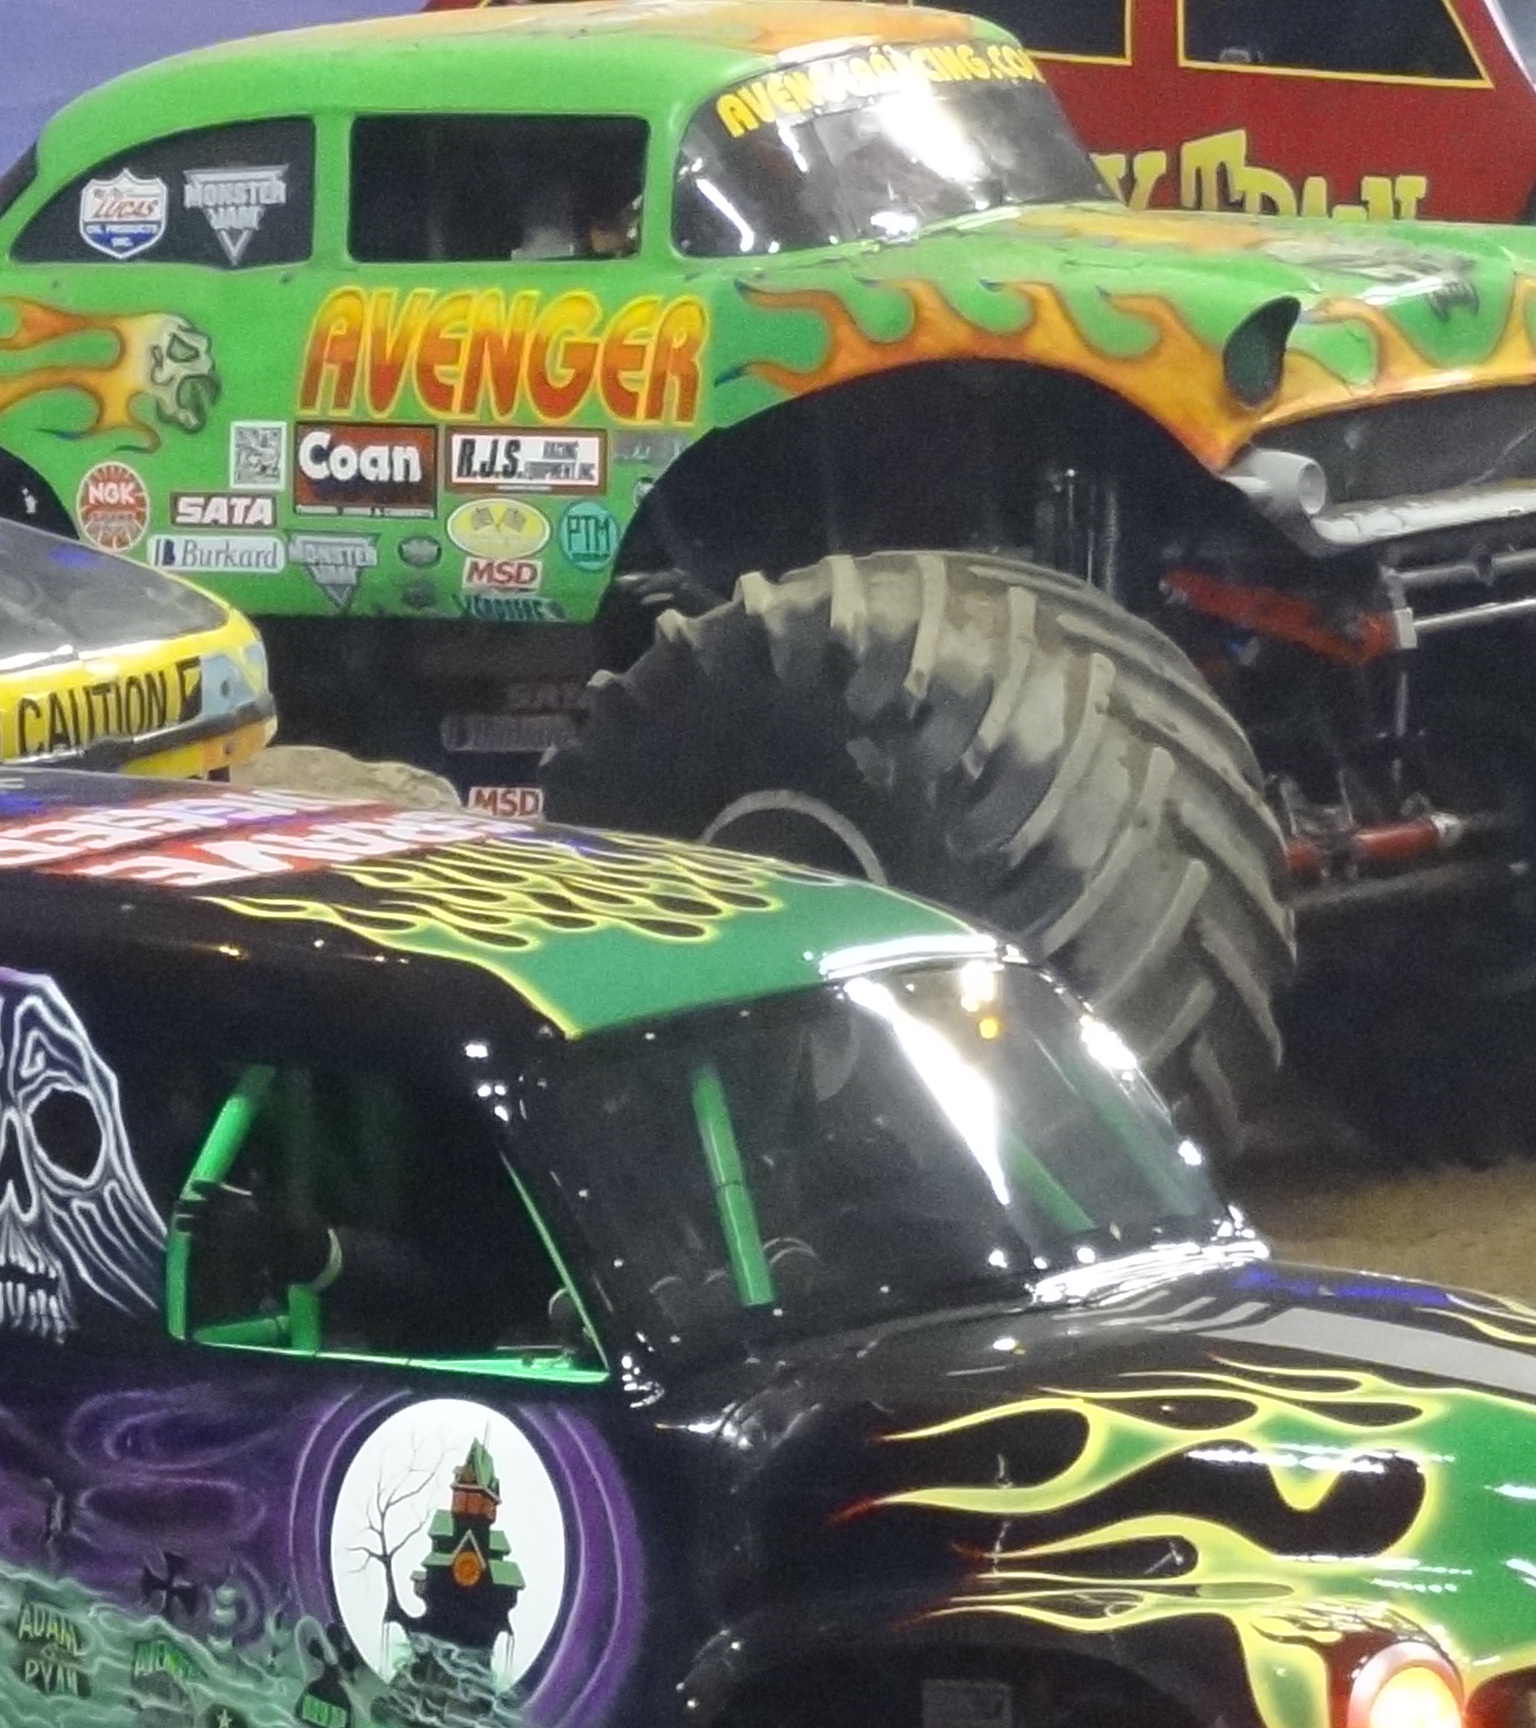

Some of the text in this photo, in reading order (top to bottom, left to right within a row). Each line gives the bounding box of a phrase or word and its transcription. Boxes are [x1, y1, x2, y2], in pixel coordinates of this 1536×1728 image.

[183, 181, 287, 208] MONSTER
[298, 284, 709, 427] AVENGER
[299, 430, 422, 484] Coan
[456, 437, 524, 479] R.J.S.
[89, 481, 135, 505] NGK
[175, 496, 273, 525] SATA
[567, 515, 611, 551] PTM
[182, 538, 278, 570] Burkard
[466, 560, 539, 585] MSD
[18, 669, 167, 756] CAUTION
[474, 789, 540, 817] MSD
